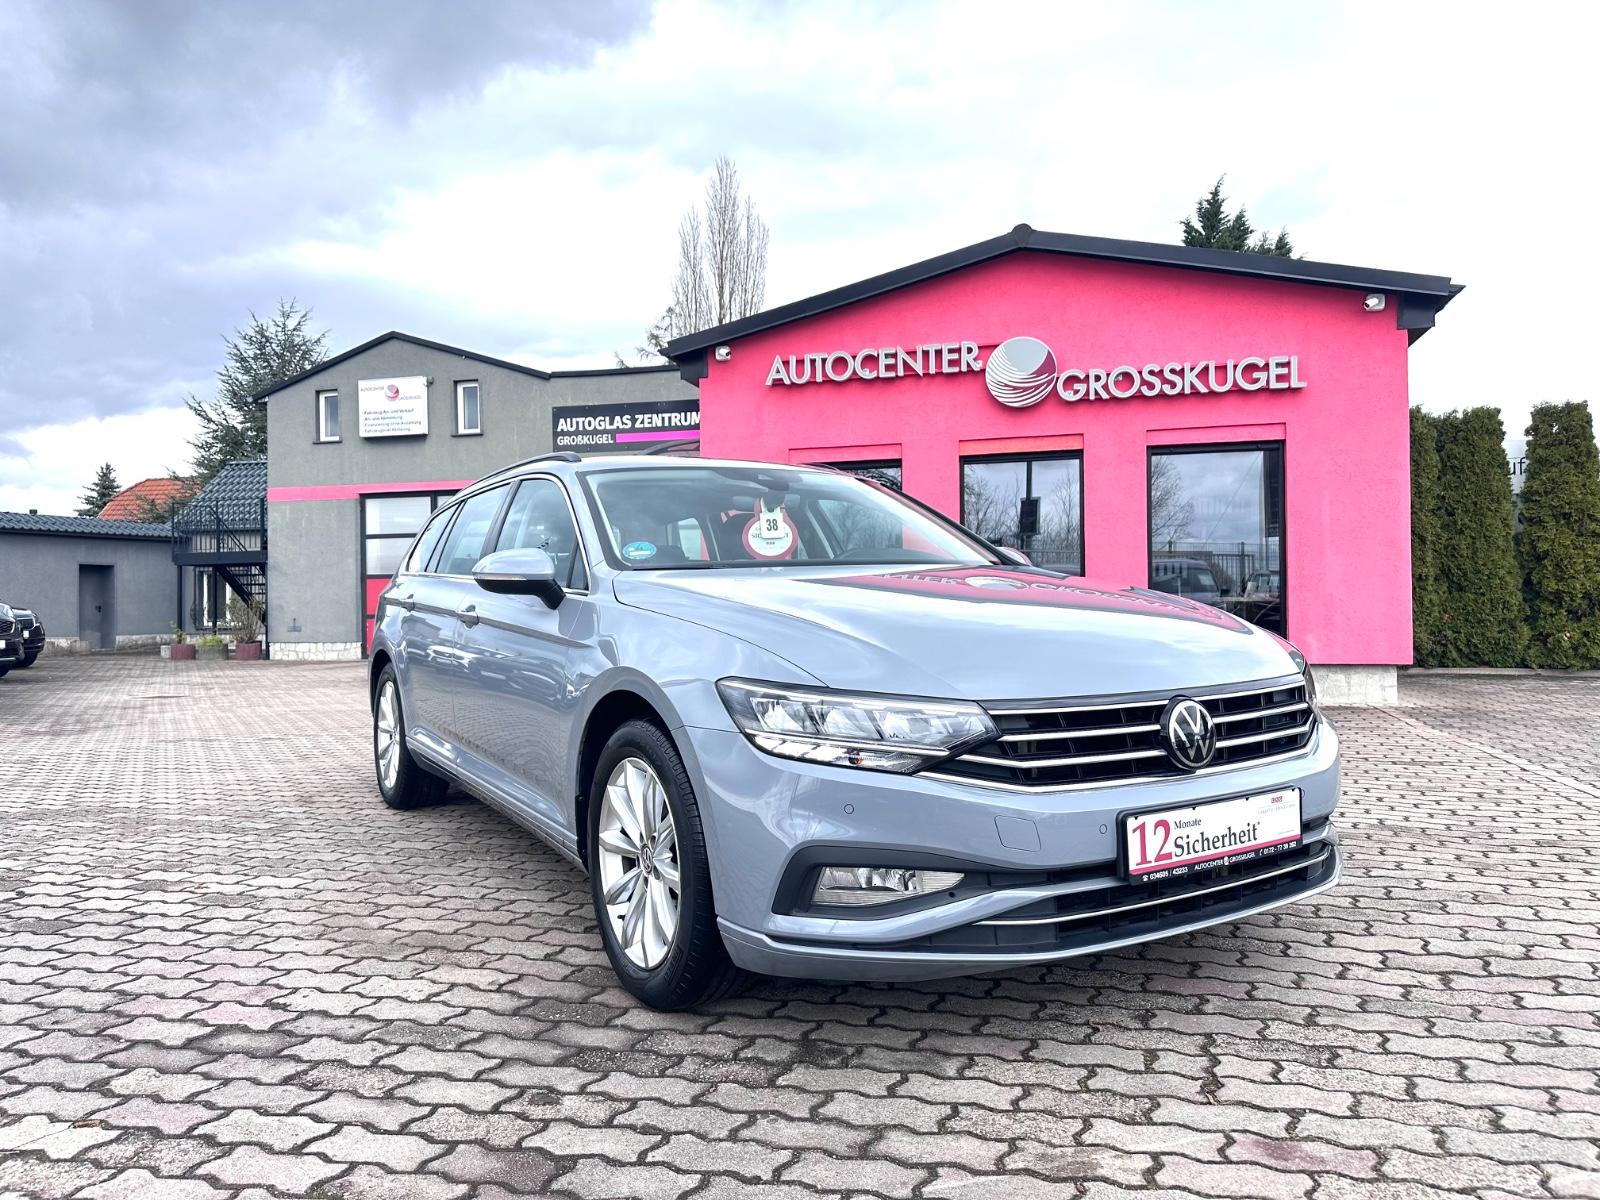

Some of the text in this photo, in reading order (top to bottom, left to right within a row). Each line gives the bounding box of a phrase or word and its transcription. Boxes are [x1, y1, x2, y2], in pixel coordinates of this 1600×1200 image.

[765, 341, 1307, 402] AUTOCENTER GROSSKUGEL
[557, 415, 632, 432] AUTOGLAS
[557, 434, 614, 446] GROßKUGEL
[766, 518, 778, 531] 38
[1174, 818, 1202, 830] Monate
[1132, 819, 1173, 866] 12
[1194, 859, 1224, 871] AUTOCENTER
